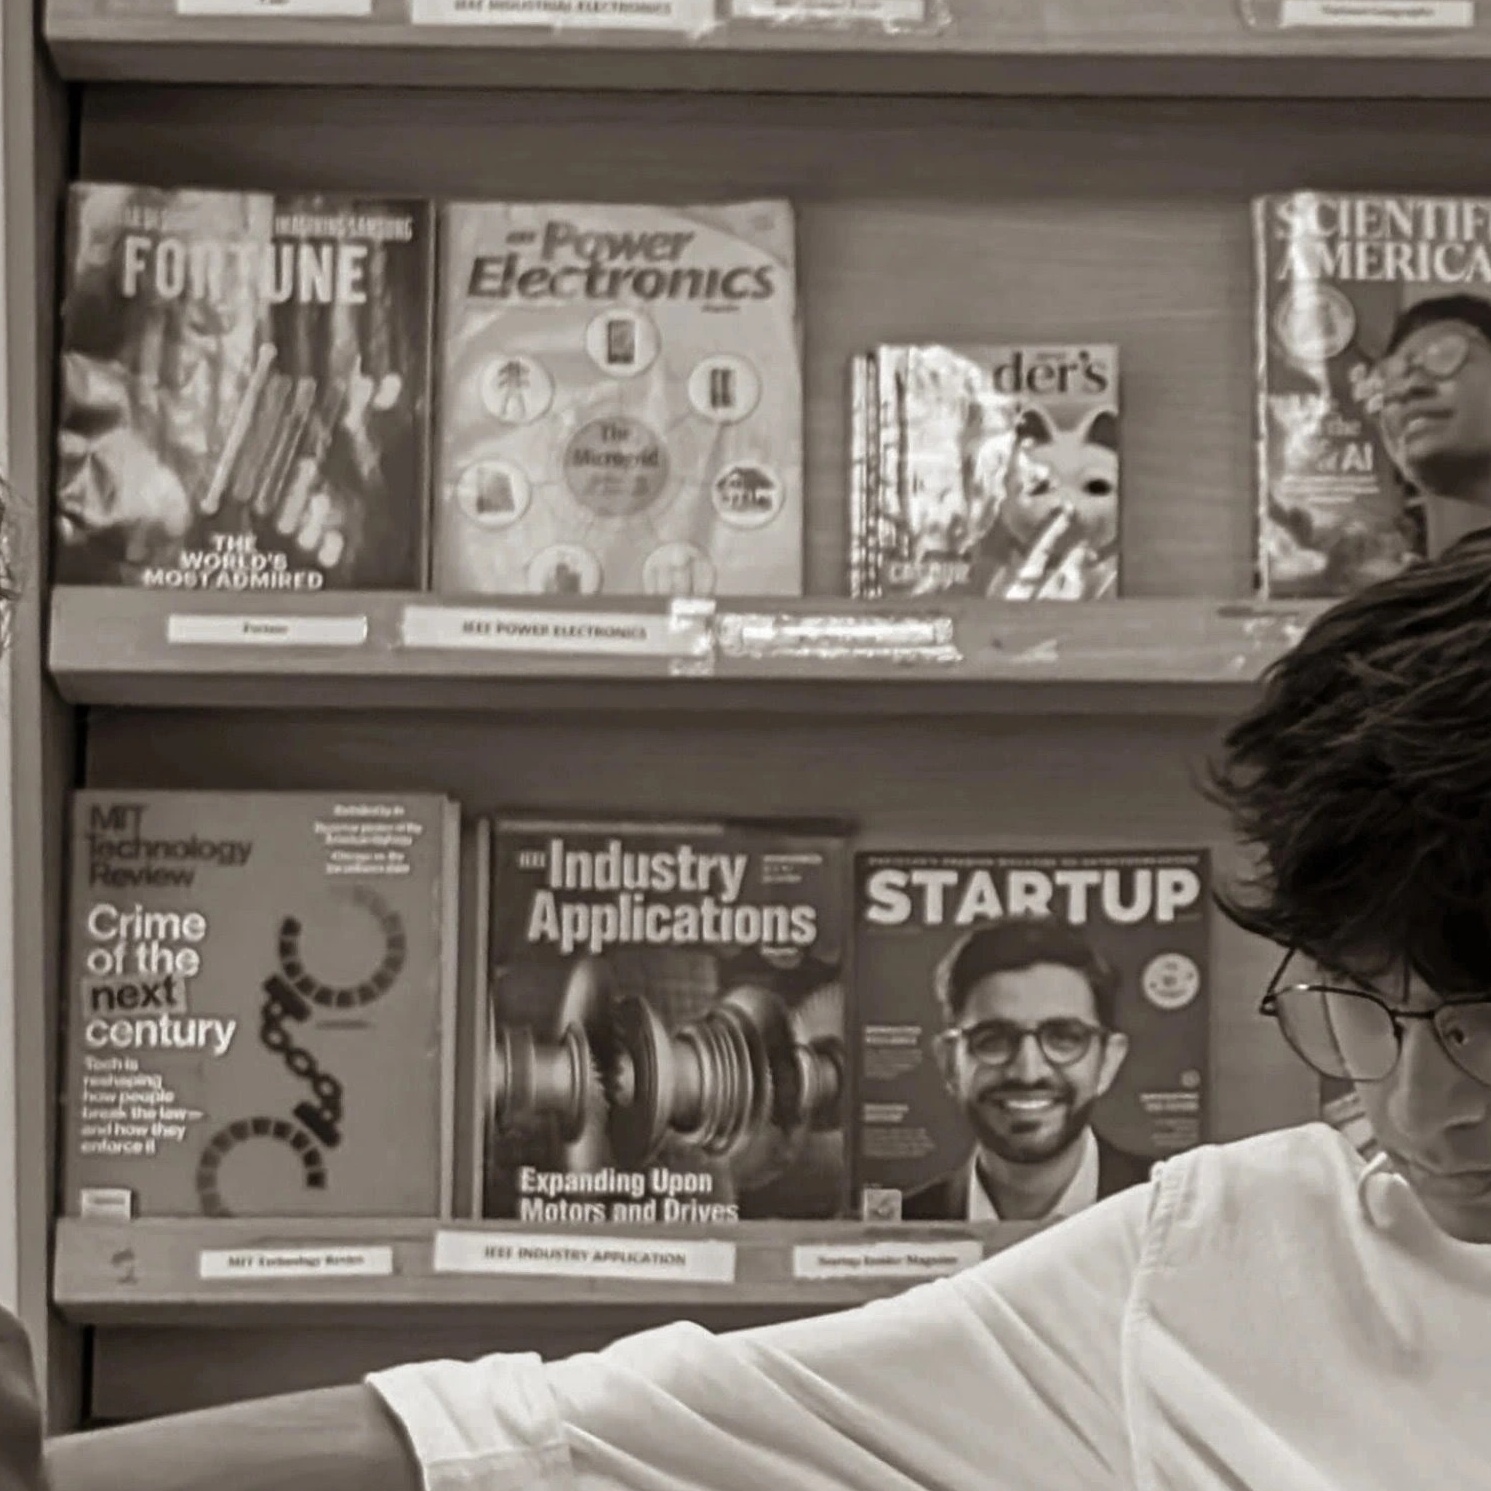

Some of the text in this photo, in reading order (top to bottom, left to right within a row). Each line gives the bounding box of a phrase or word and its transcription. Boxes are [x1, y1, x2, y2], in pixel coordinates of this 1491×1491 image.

[540, 219, 696, 262] Power
[122, 233, 369, 305] FORTUNE
[467, 252, 775, 300] Electronics
[1341, 442, 1375, 473] AI
[210, 533, 258, 553] THE
[180, 551, 289, 573] WORLD'S
[142, 569, 325, 591] MOST ADMIRED
[462, 620, 648, 641] IEEE POWER ELECTRONICS
[89, 803, 146, 830] MIT
[86, 834, 254, 868] Technology
[87, 862, 197, 888] Review
[549, 837, 749, 904] Industry
[866, 868, 1201, 925] STARTUP
[87, 902, 207, 942] Crime
[526, 889, 819, 956] Applications
[86, 939, 201, 977] of the
[90, 974, 178, 1011] next
[85, 1012, 237, 1056] century
[520, 1165, 714, 1199] Expanding Upon
[520, 1197, 740, 1222] Motors and Drives
[484, 1245, 687, 1267] IEEE INDUSTRY APPLICATION
